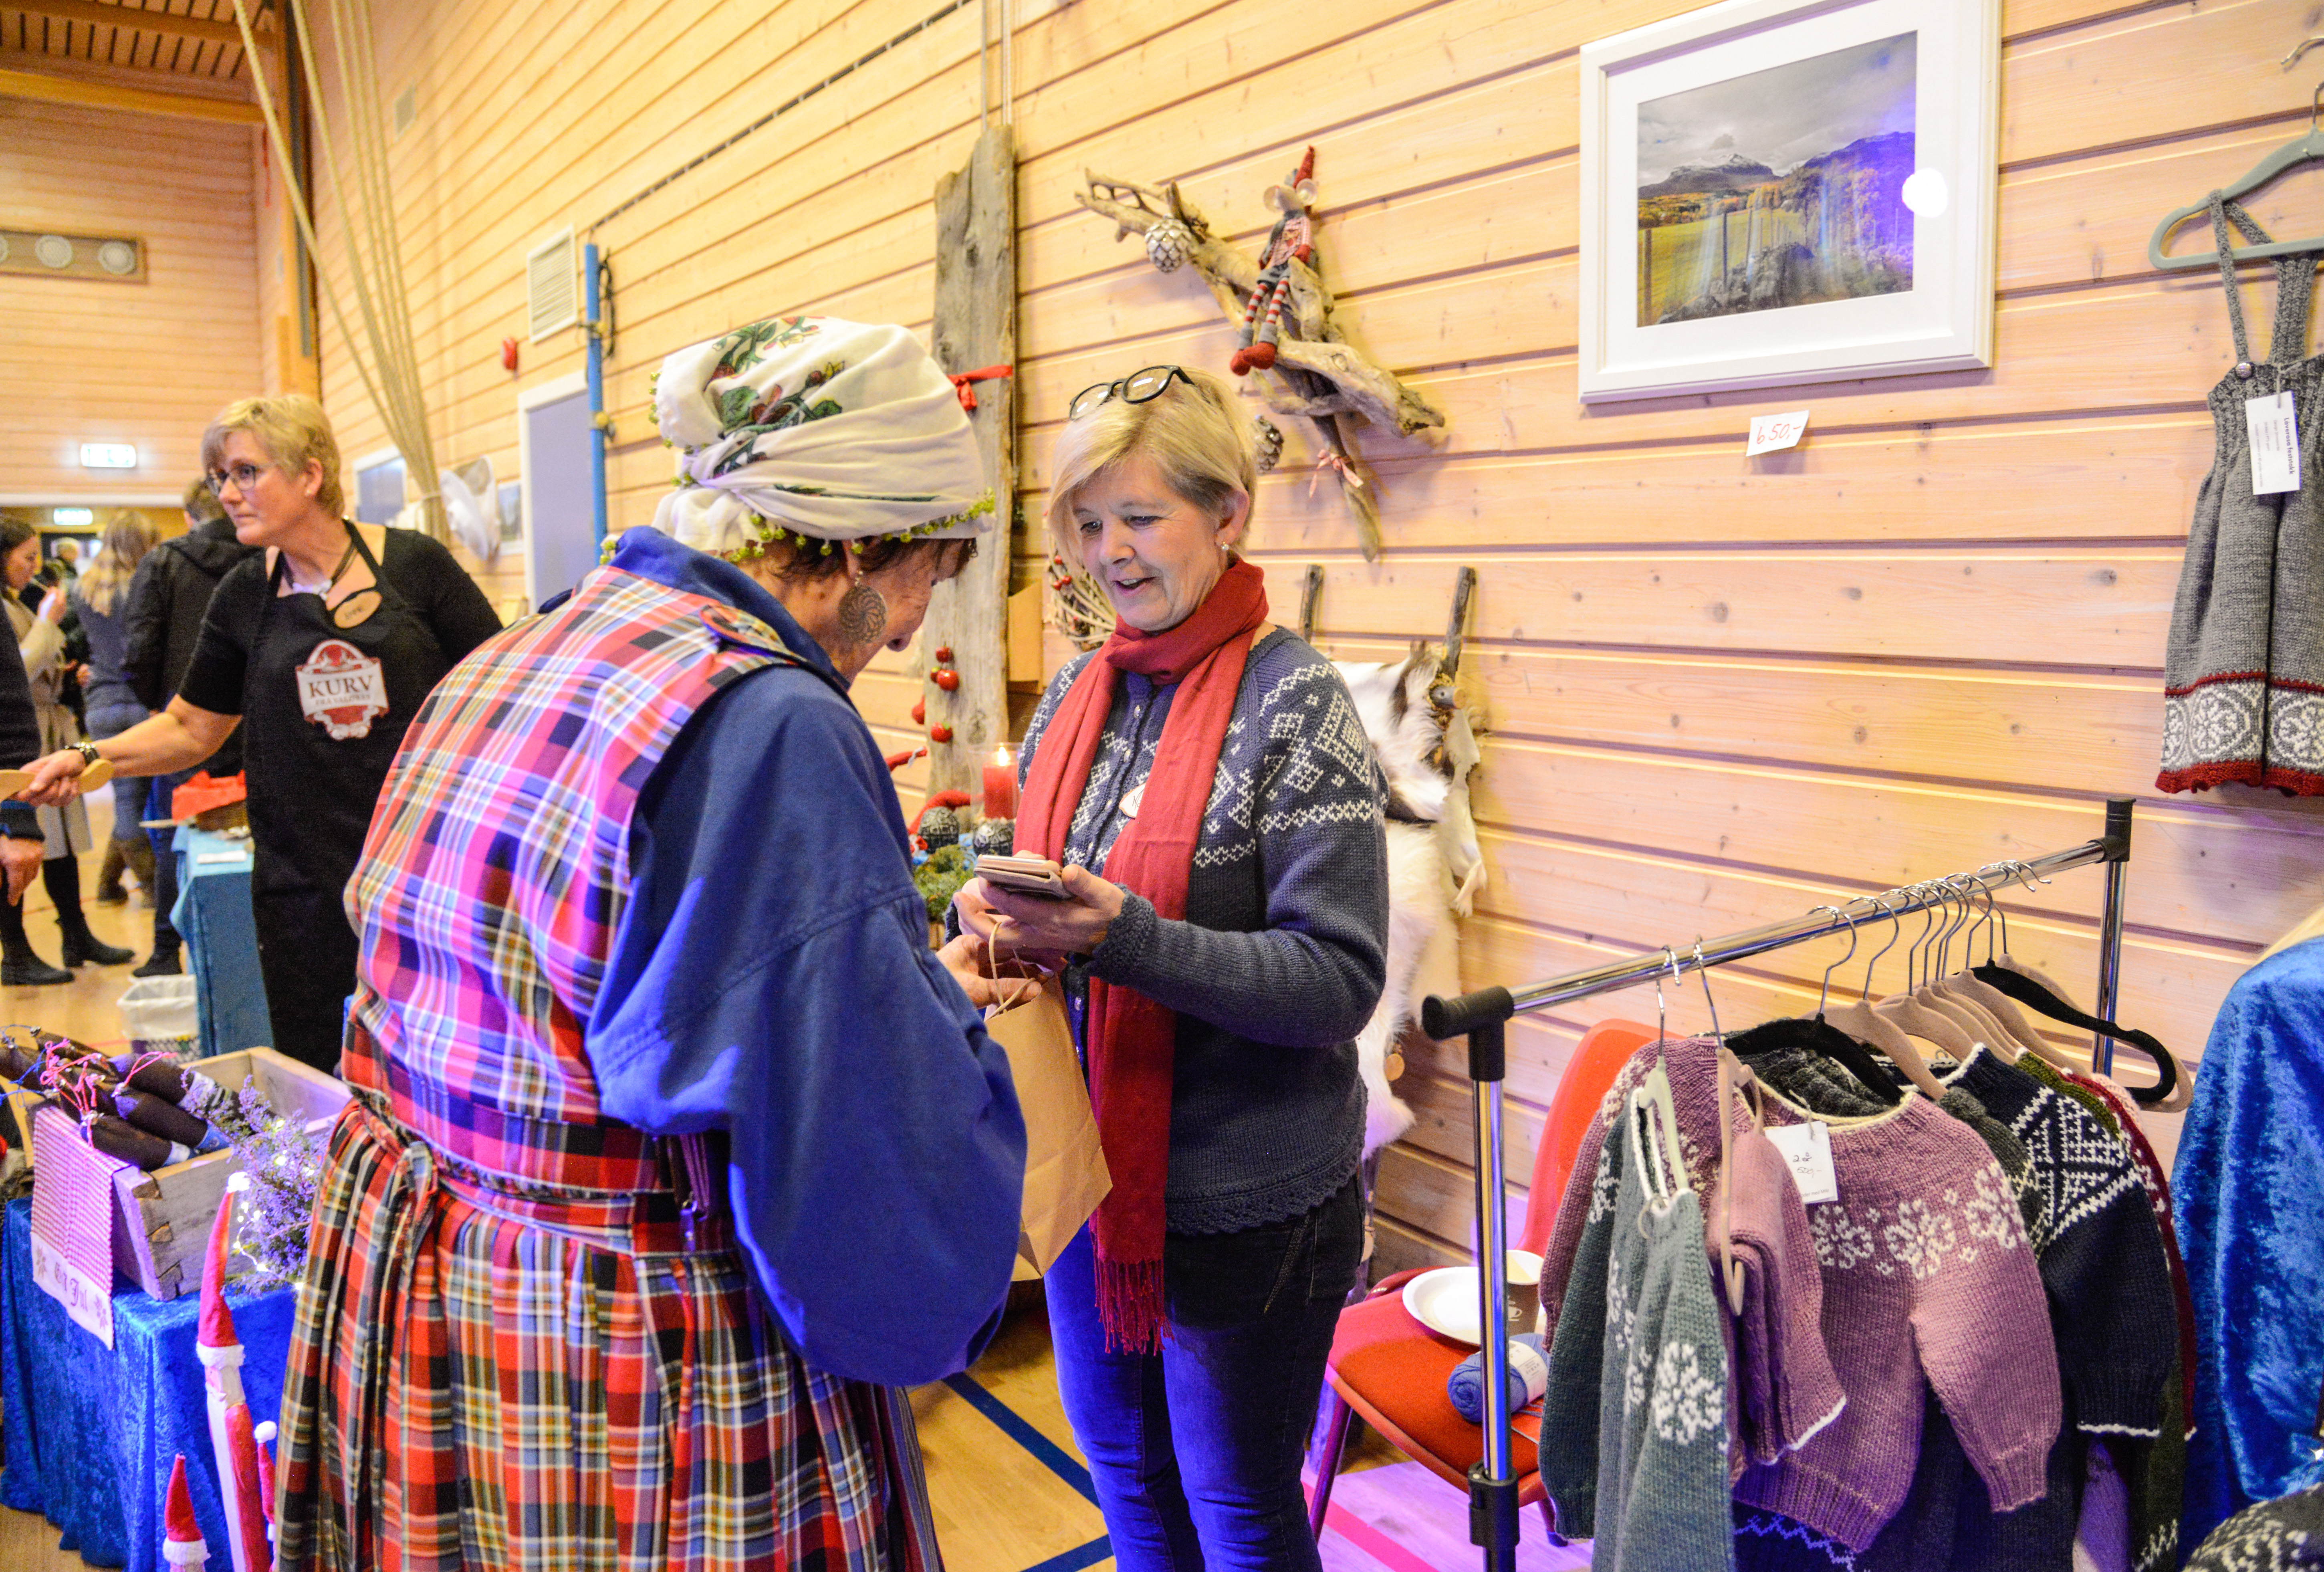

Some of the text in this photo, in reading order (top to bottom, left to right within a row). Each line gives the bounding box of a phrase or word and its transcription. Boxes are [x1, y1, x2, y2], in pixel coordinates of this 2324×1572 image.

[1756, 423, 1802, 444] 650,-
[2287, 447, 2296, 475] feststakk
[308, 675, 373, 698] KURV
